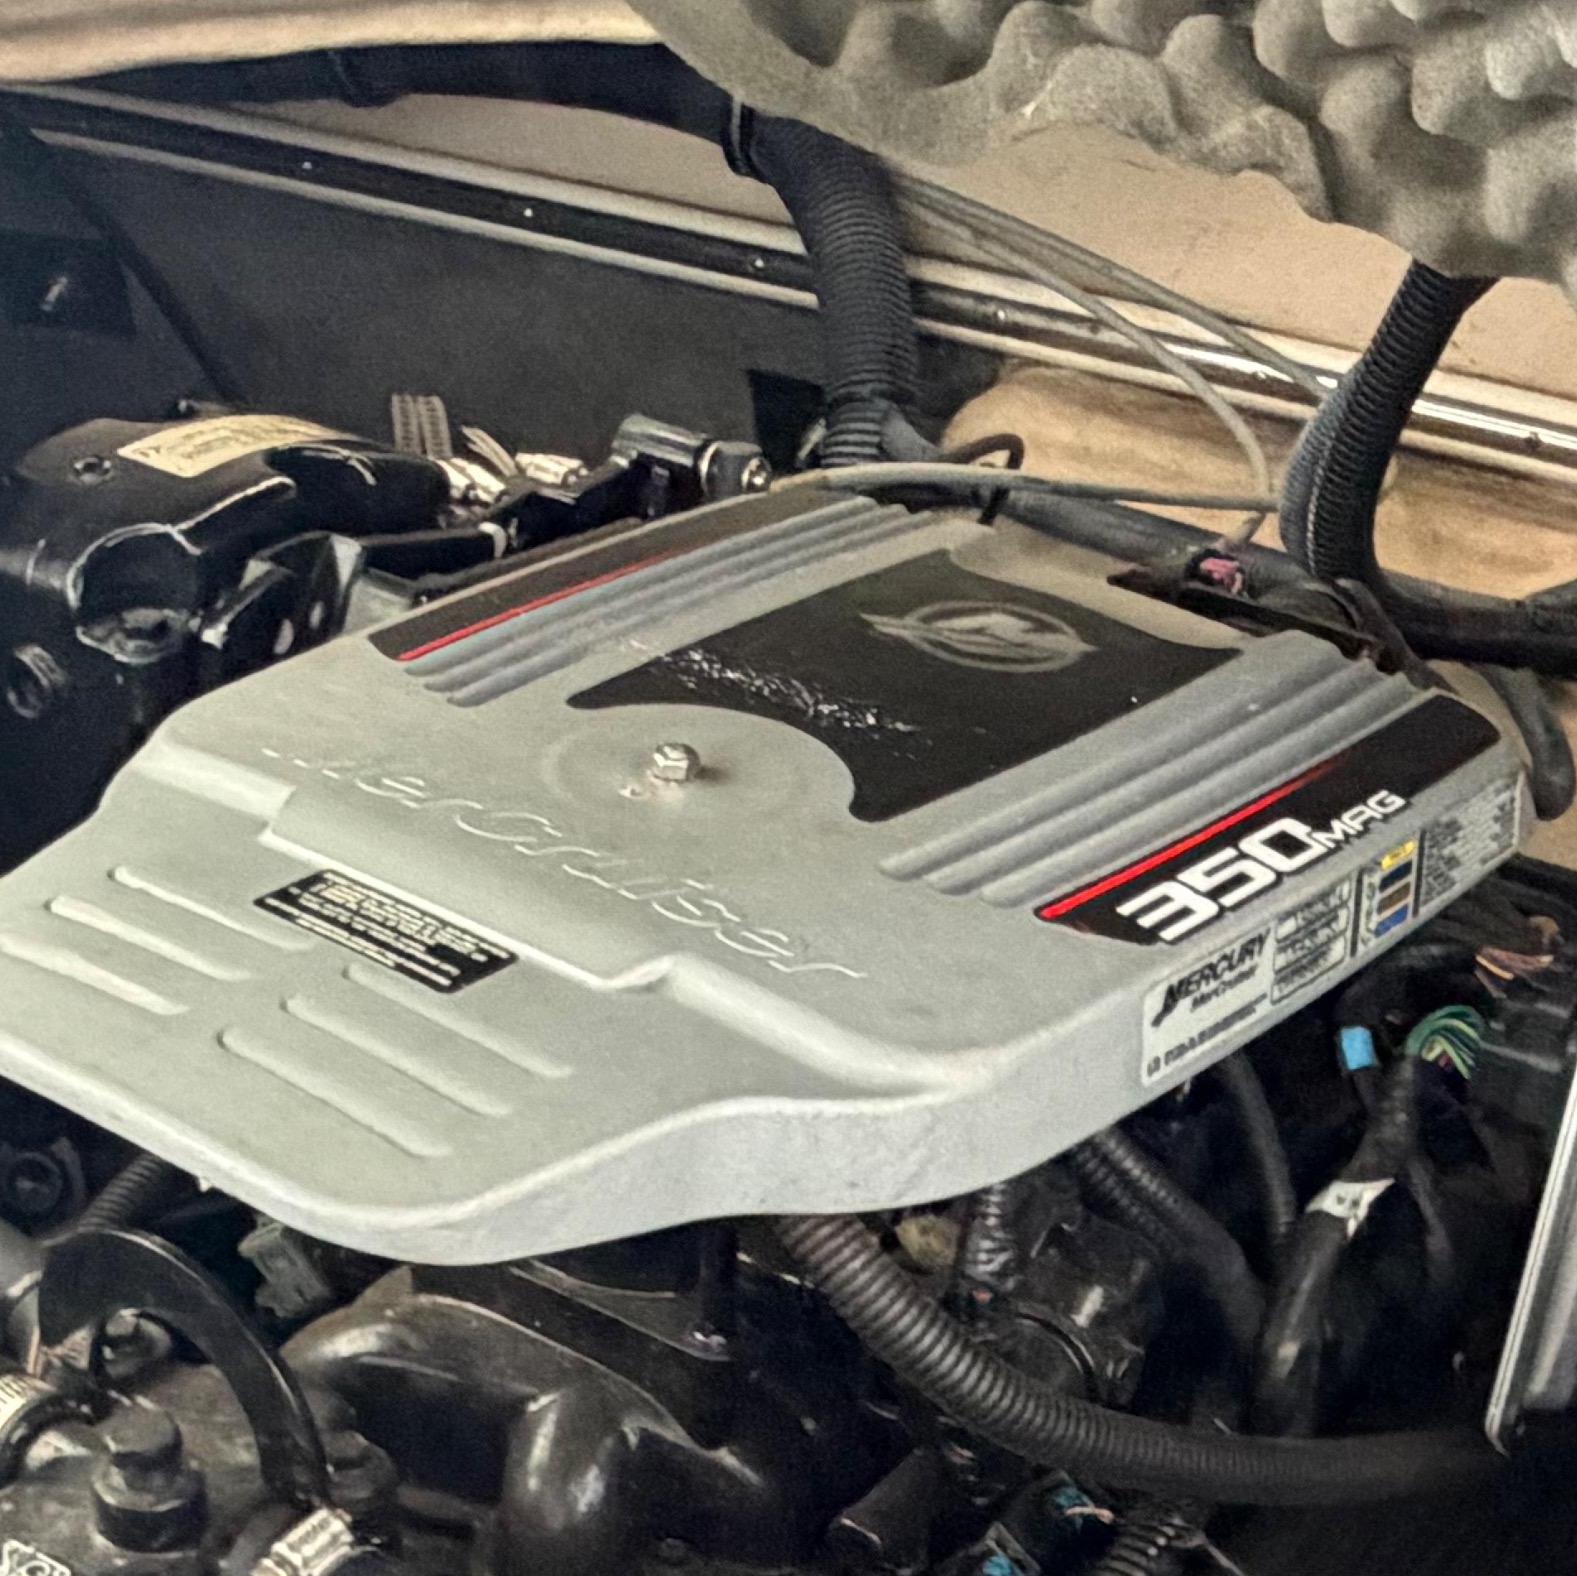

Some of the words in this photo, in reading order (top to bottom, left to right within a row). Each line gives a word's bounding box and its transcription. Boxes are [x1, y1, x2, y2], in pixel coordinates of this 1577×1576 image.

[1115, 817, 1317, 941] 350
[1312, 789, 1405, 850] MAG
[1151, 927, 1271, 1027] MERCURY
